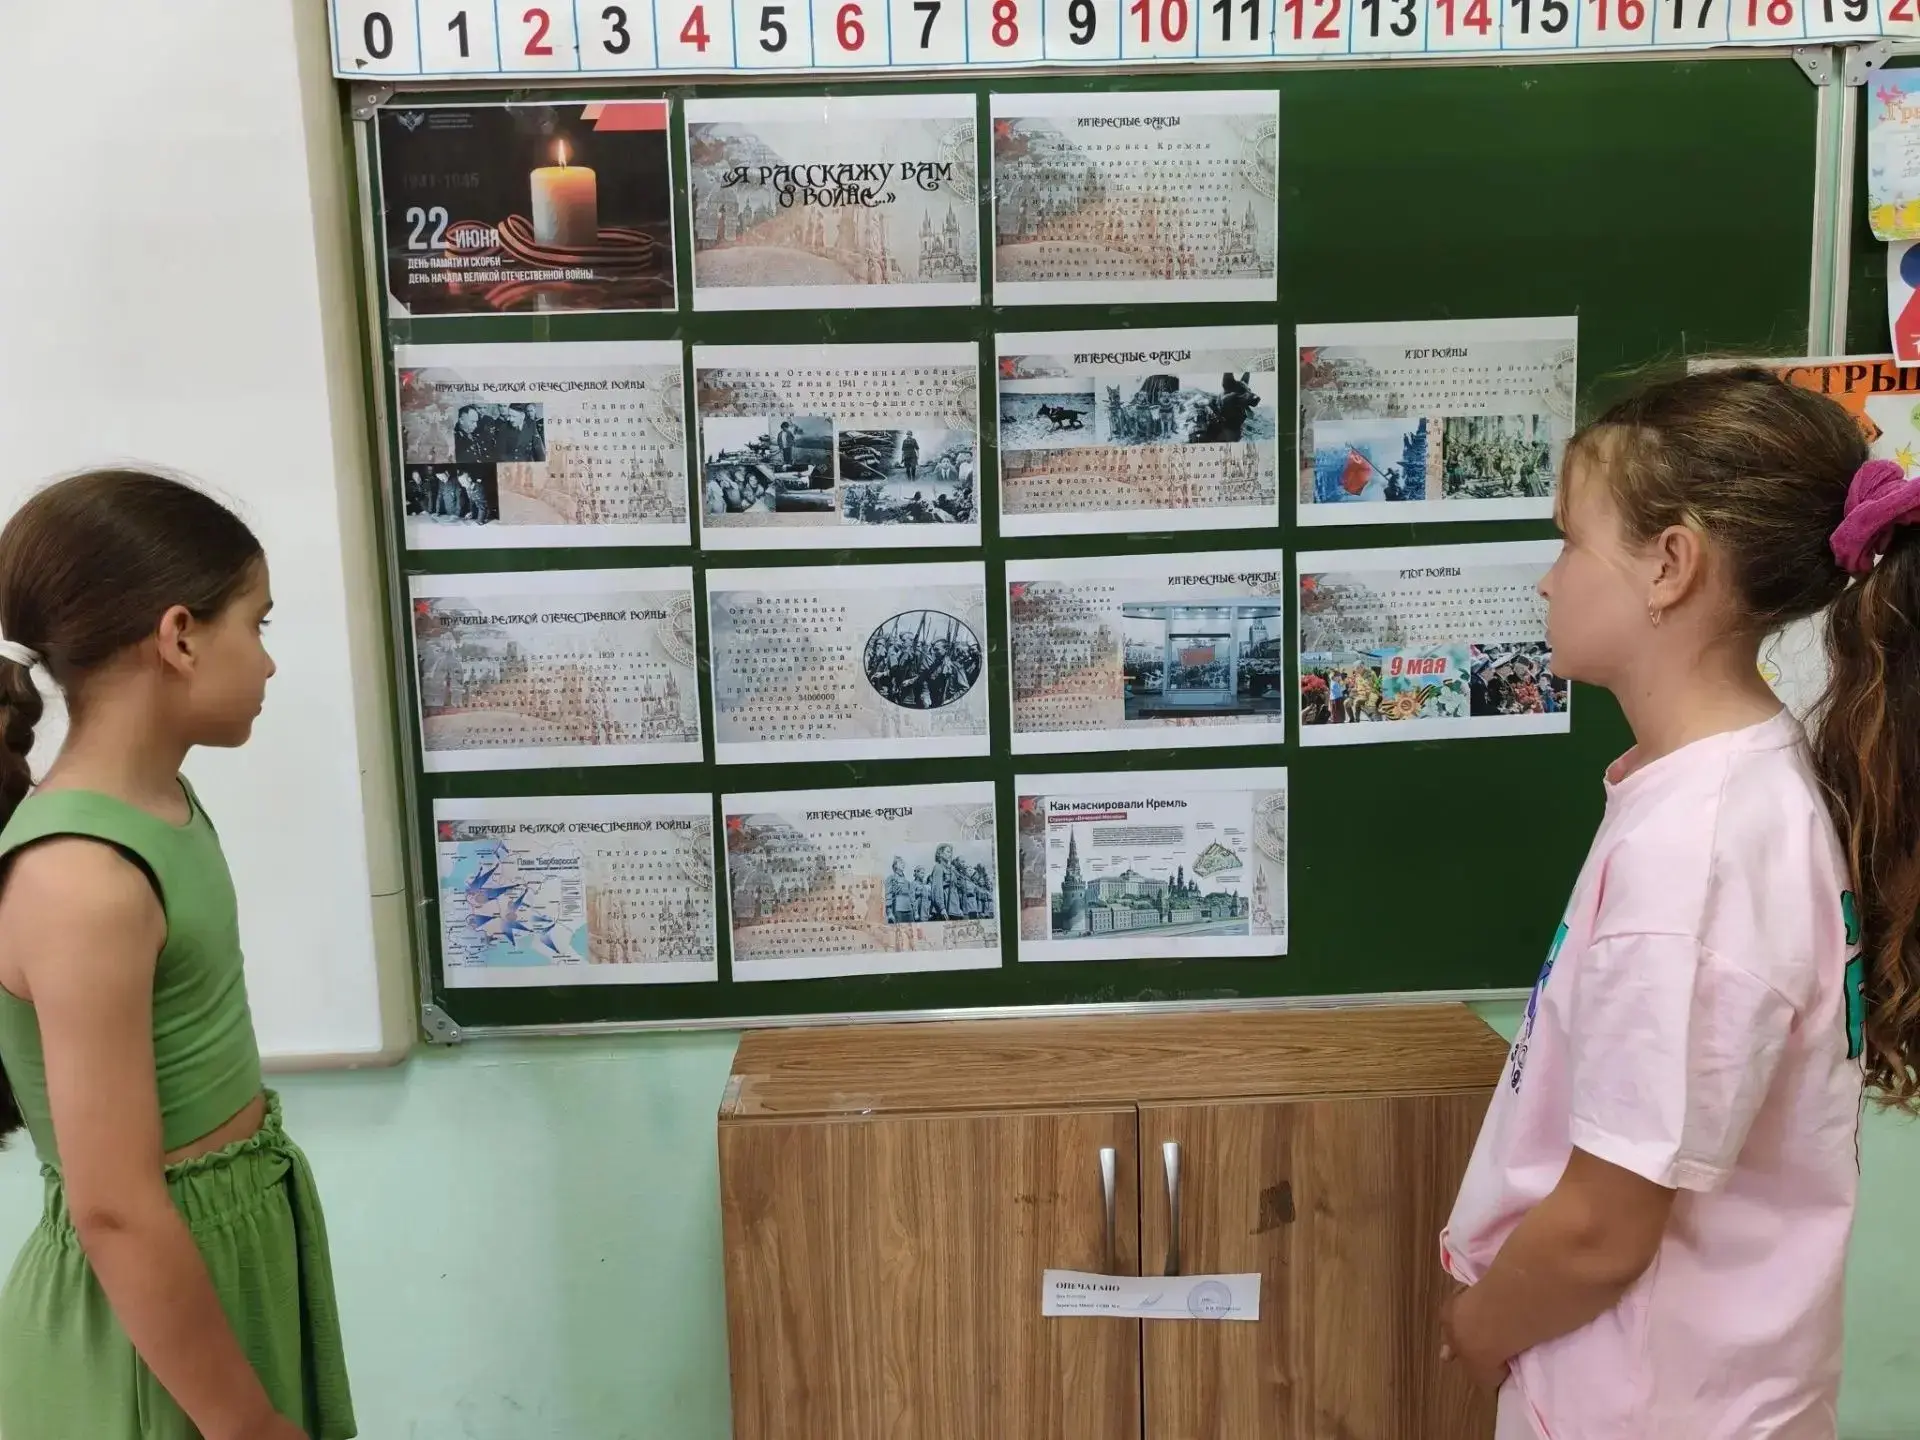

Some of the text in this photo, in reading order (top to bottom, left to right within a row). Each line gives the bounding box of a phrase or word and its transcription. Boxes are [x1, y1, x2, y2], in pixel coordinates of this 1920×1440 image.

[364, 12, 394, 59] 0
[447, 11, 469, 58] 1
[523, 8, 553, 55] 2
[602, 6, 631, 54] 3
[679, 5, 710, 52] 4
[759, 5, 788, 52] 5
[835, 3, 865, 51] 6
[913, 1, 941, 49] 7
[991, 0, 1019, 48] 8
[1069, 0, 1096, 45] 9
[1130, 0, 1188, 43] 10
[1212, 0, 1259, 41] 11
[1284, 0, 1341, 40] 12
[1366, 0, 1417, 37] 13
[1438, 0, 1493, 35] 14
[1519, 0, 1569, 34] 15
[1594, 0, 1645, 31] 16
[1671, 0, 1714, 29] 17
[1745, 0, 1794, 27] 18
[1077, 116, 1180, 130] ИНТЕРЕСНЫЕ ФАКТЫ
[759, 163, 896, 196] РАССКАЖУ
[900, 161, 953, 191] ВАМ
[406, 206, 500, 250] 22 ИЮНЯ
[408, 256, 501, 269] ДЕНЬ ПАМЯТИ И СКОРБИ
[409, 268, 593, 284] ДЕНЬ НАЧАЛА ВЕЛИКОЙ ОТЕЧЕСТВЕННОЙ ВОЙНЫ
[1074, 350, 1191, 365] ИНТЕРЕСНЫЕ ФАКТЫ
[1405, 347, 1467, 359] ИТОГ ВОЙНЫ
[528, 379, 609, 392] ОТЕЧЕСТВЕННОЙ
[611, 380, 645, 390] ВОЙНЫ
[781, 380, 792, 388] 22
[838, 379, 856, 387] 1941
[907, 388, 942, 396] СССР
[1168, 572, 1277, 586] ИНТЕРЕСНЫЕ ФАКТЫ
[1400, 566, 1461, 579] ИТОГ ВОЙНЫ
[439, 609, 667, 626] ПРИЧИНЫ ВЕЛИКОЙ ОТЕЧЕСТВЕННОЙ ВОЙНЫ
[1391, 656, 1447, 675] 9 мая
[1050, 799, 1188, 811] Как маскировали Кремль
[806, 807, 913, 821] ИНТЕРЕСНЫЕ ФАКТЫ
[469, 819, 691, 834] ПРИЧИНЫ ВЕЛИКОЙ ОТЕЧЕСТВЕННОЙ ВОЙНЫ
